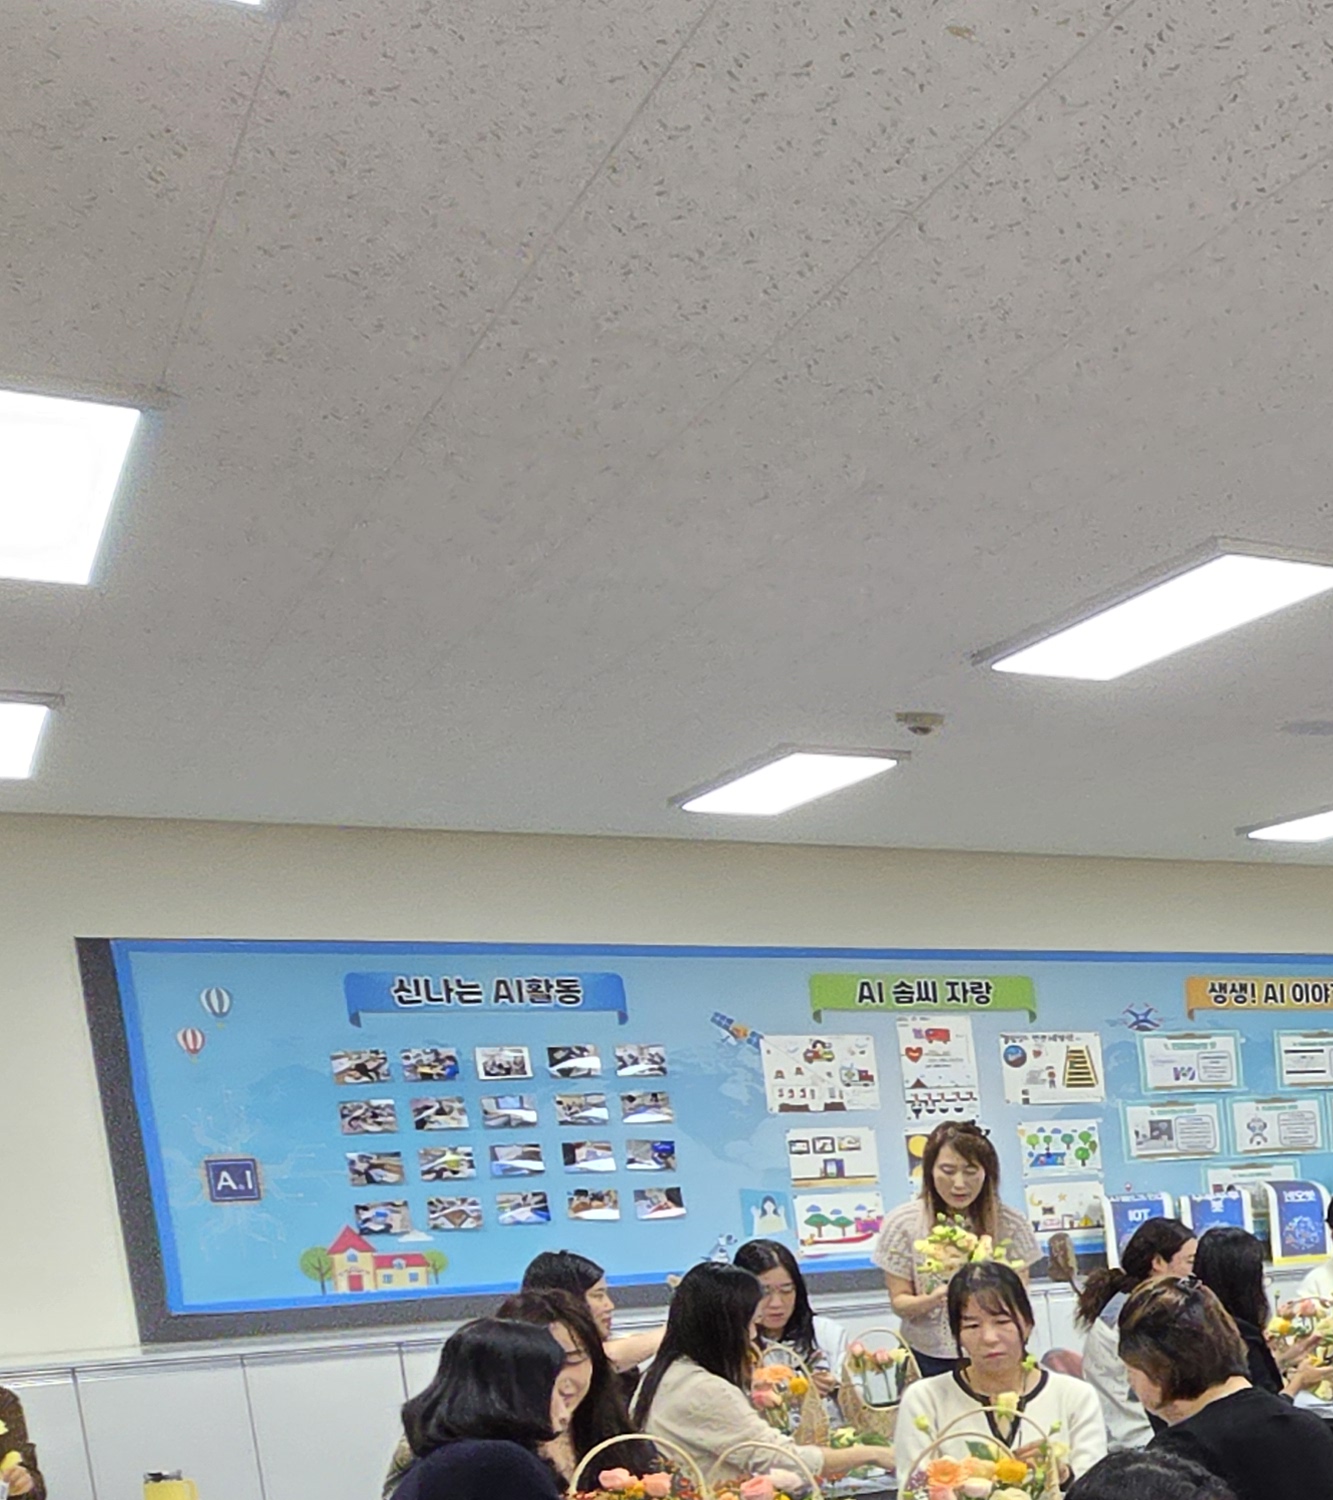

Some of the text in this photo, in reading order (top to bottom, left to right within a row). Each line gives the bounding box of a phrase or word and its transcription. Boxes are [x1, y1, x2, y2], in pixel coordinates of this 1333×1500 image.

[394, 978, 582, 1005] 신나는 AI활동
[858, 980, 993, 1005] AI 솜씨 자랑
[1208, 982, 1256, 1004] 생생!
[1264, 983, 1285, 1003] AI
[217, 1169, 253, 1191] A.I
[1127, 1208, 1150, 1221] IOT
